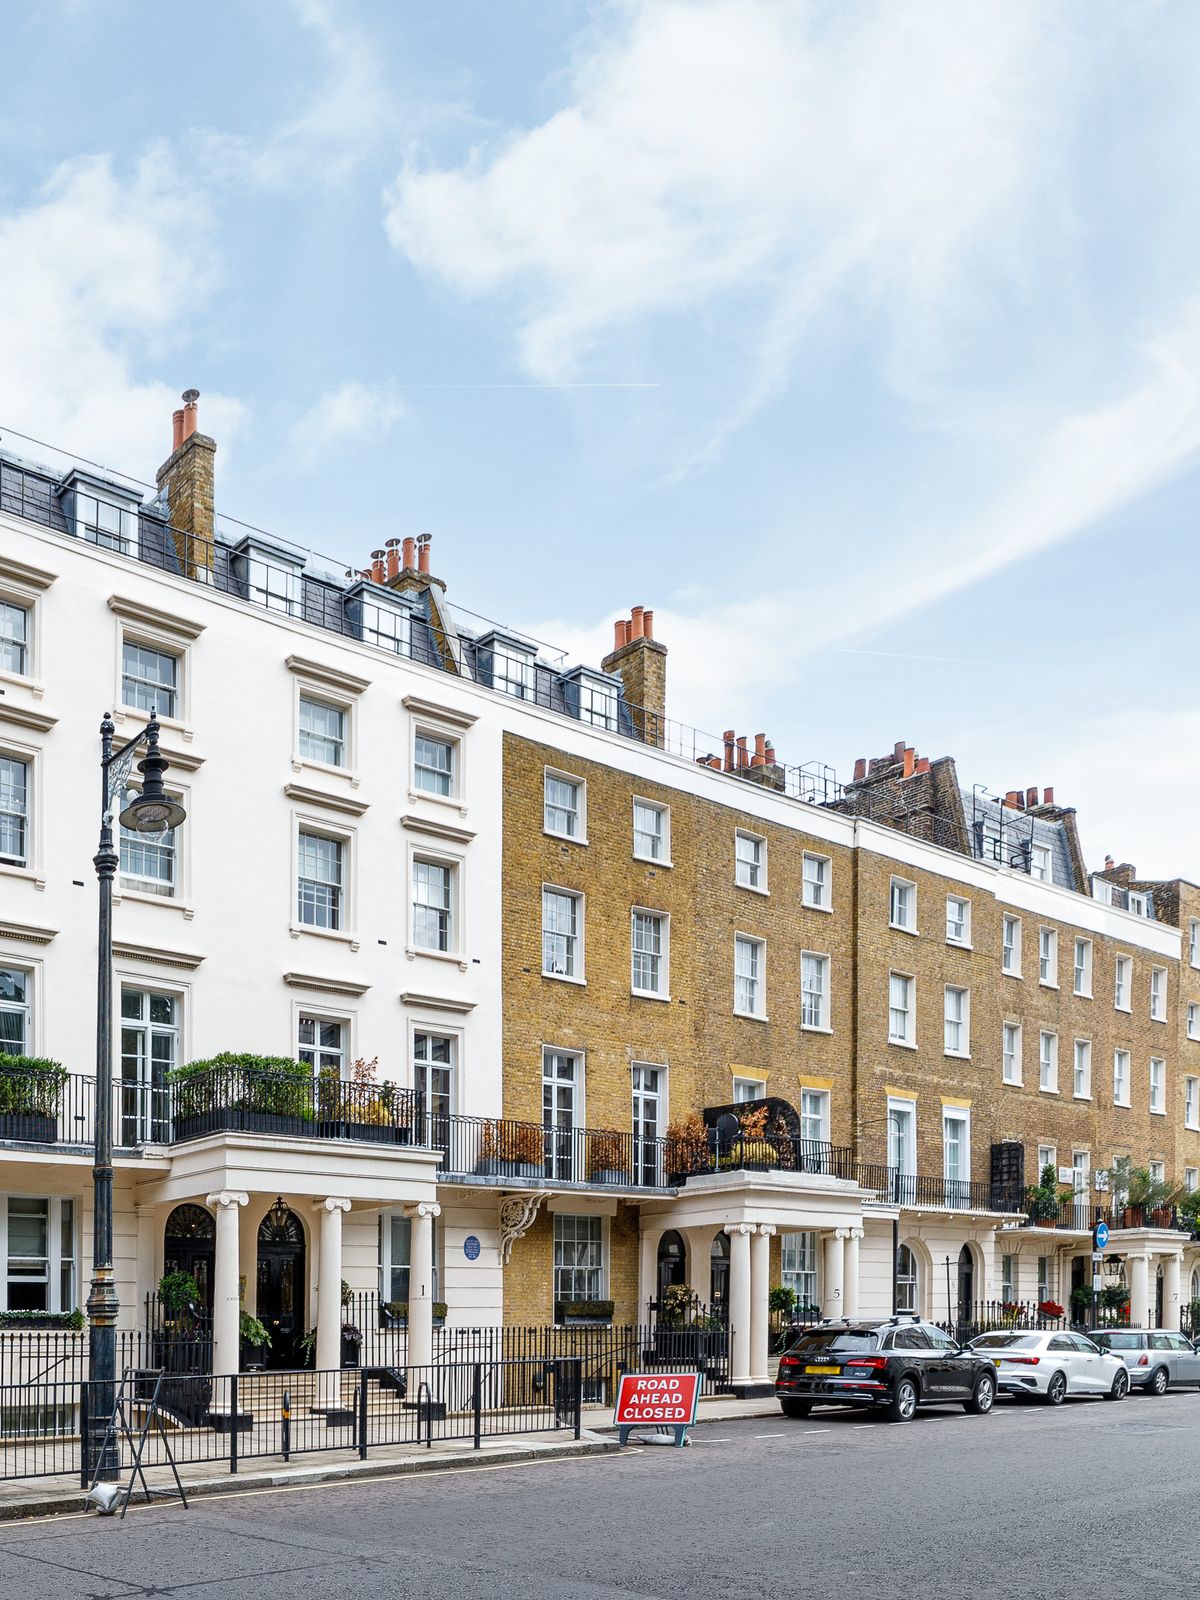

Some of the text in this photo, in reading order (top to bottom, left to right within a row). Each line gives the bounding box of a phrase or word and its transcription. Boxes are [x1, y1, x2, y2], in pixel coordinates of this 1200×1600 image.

[833, 1288, 841, 1299] 5
[637, 1379, 680, 1391] ROAD
[629, 1393, 683, 1405] AHEAD
[623, 1407, 686, 1419] CLOSED
